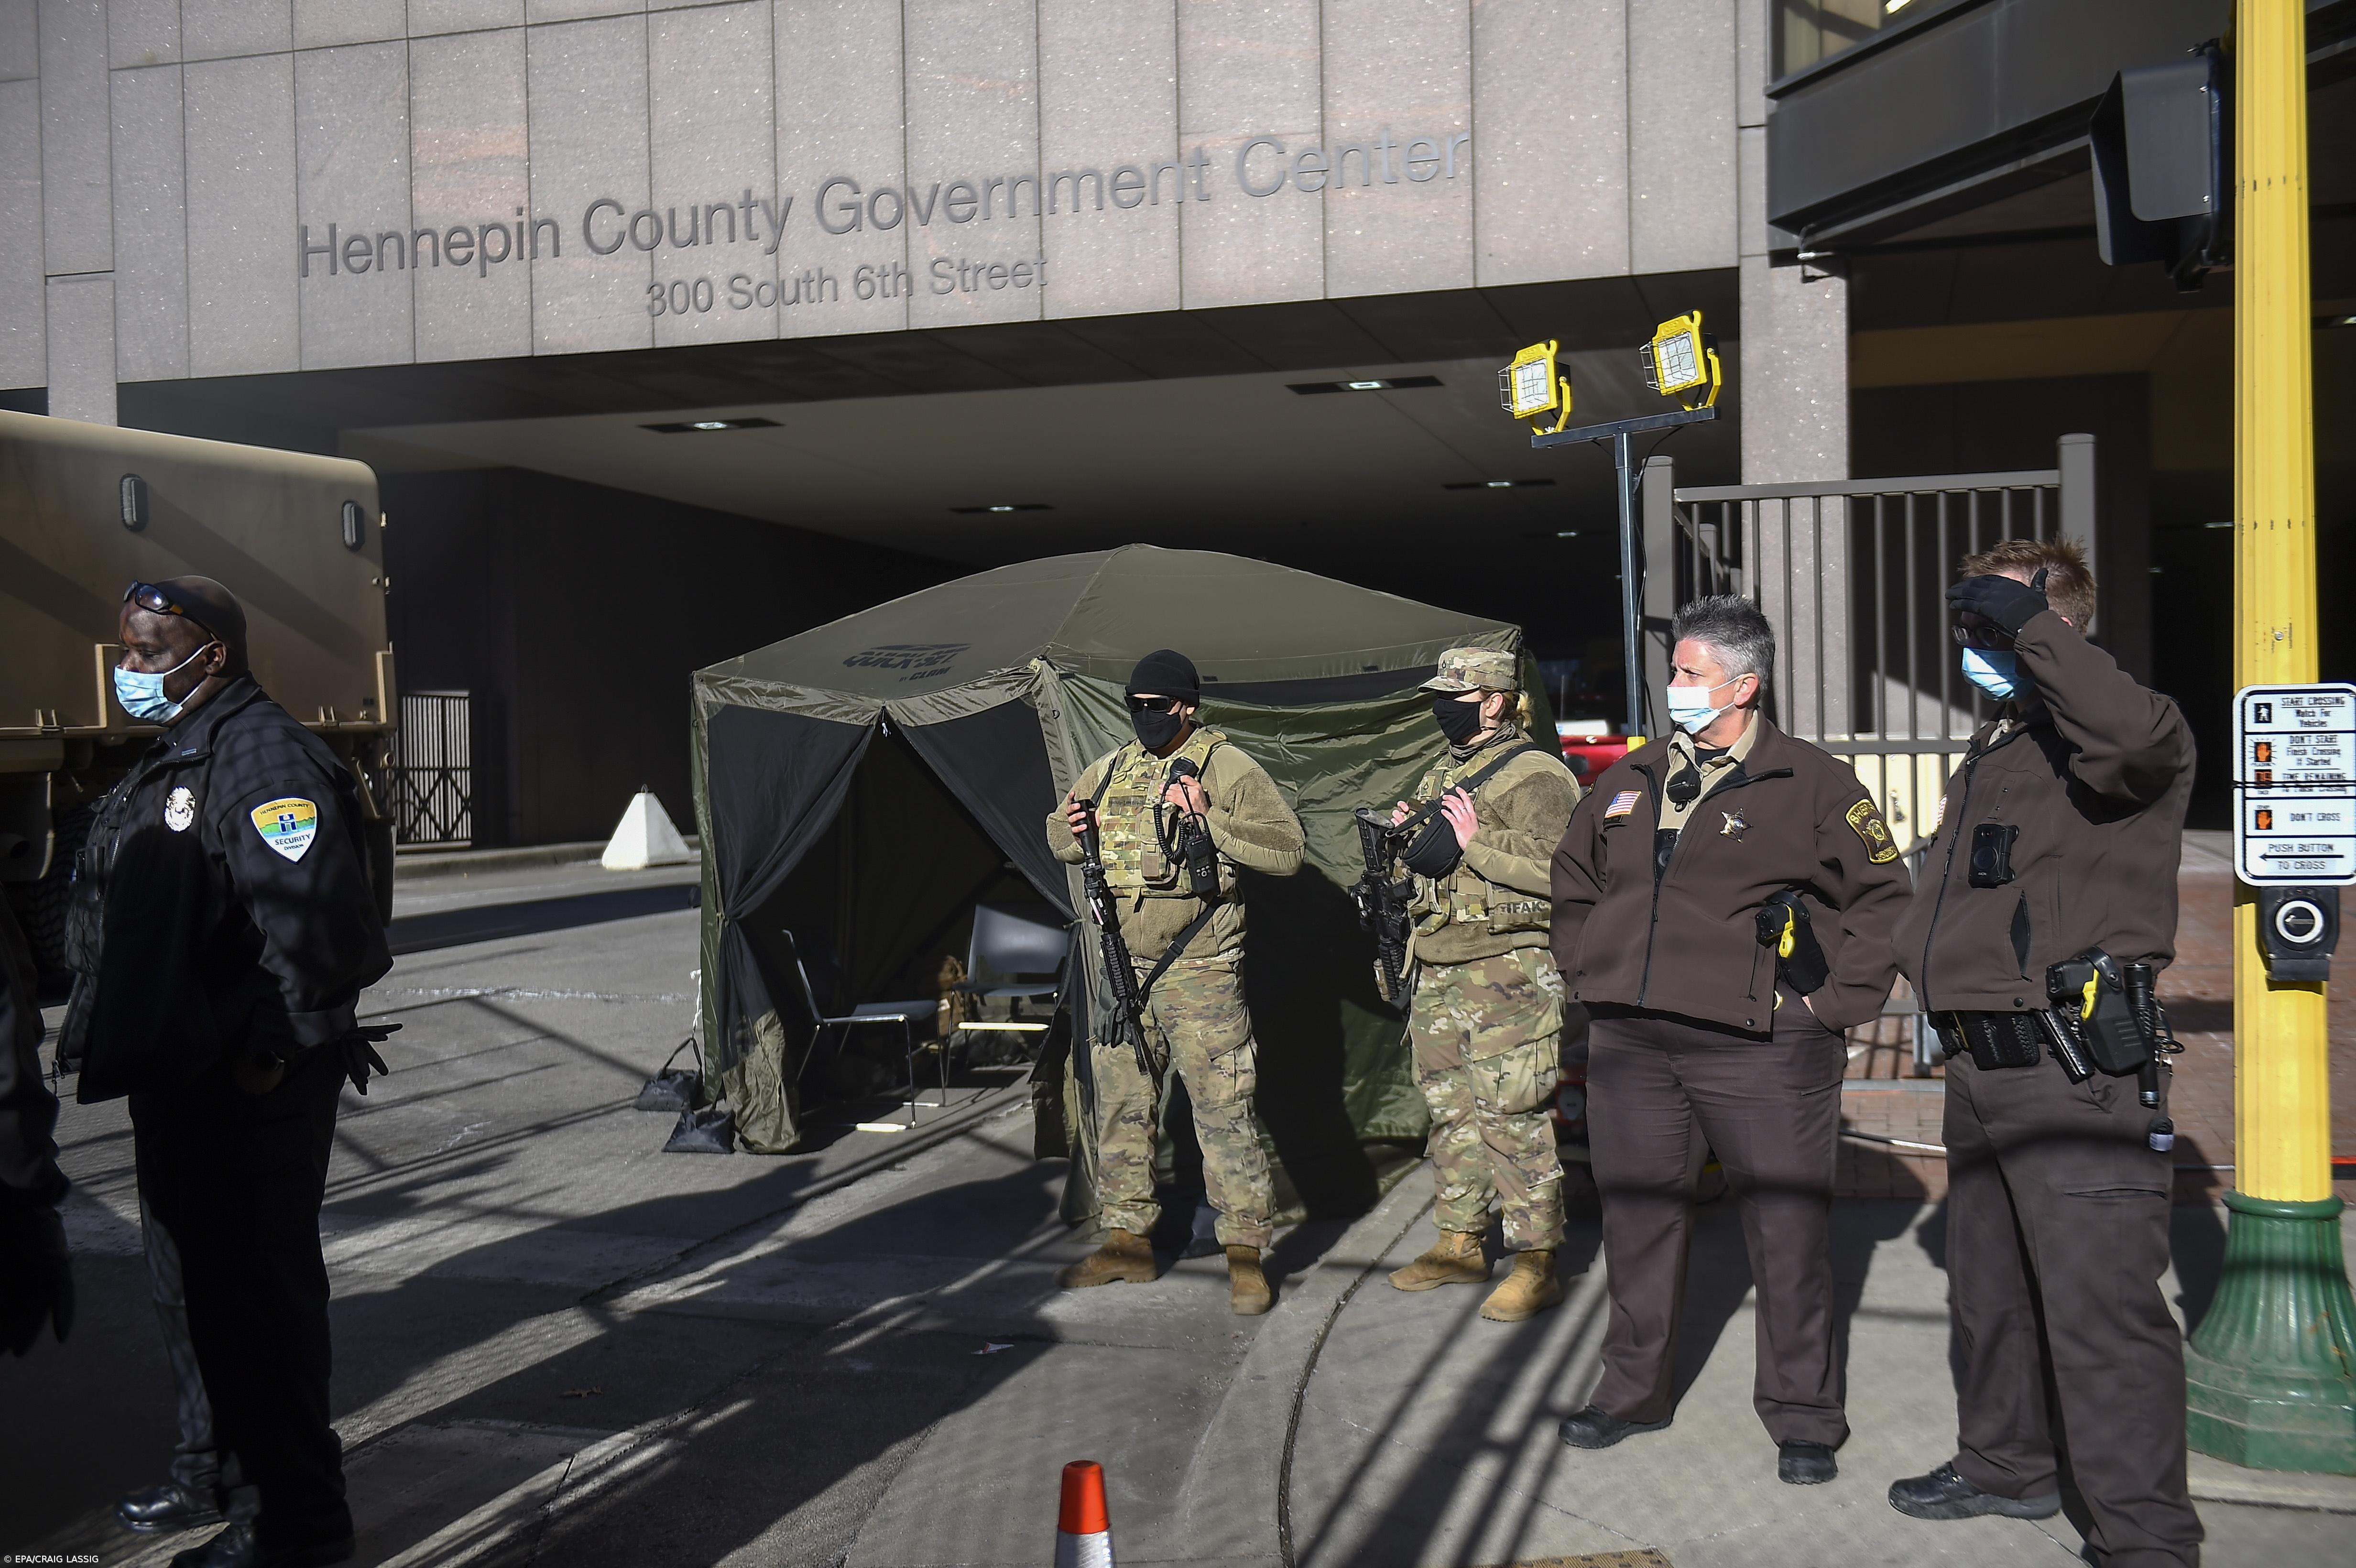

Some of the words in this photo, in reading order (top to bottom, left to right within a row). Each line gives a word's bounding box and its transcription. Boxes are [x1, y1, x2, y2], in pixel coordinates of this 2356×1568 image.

[301, 207, 560, 278] Hennepin
[583, 189, 794, 255] County
[816, 145, 1210, 235] Government
[1237, 129, 1469, 197] Center
[646, 281, 714, 316] 300
[727, 266, 838, 311] South
[853, 261, 914, 300] 6th
[928, 250, 1047, 295] Street
[909, 666, 953, 681] CLAM
[2281, 697, 2304, 706] START
[2308, 696, 2345, 706] CROSSING
[2289, 735, 2312, 744] DON'T
[2315, 734, 2338, 743] START
[1850, 804, 1876, 824] SHER
[2290, 813, 2313, 821] DON'T
[2317, 813, 2341, 821] CROSS
[274, 833, 311, 845] SECURITY
[2268, 843, 2294, 853] PUSH
[2298, 843, 2335, 852] BUTTON
[2278, 860, 2290, 870] TO
[2294, 860, 2326, 870] CROSS
[1506, 901, 1543, 914] IFAK
